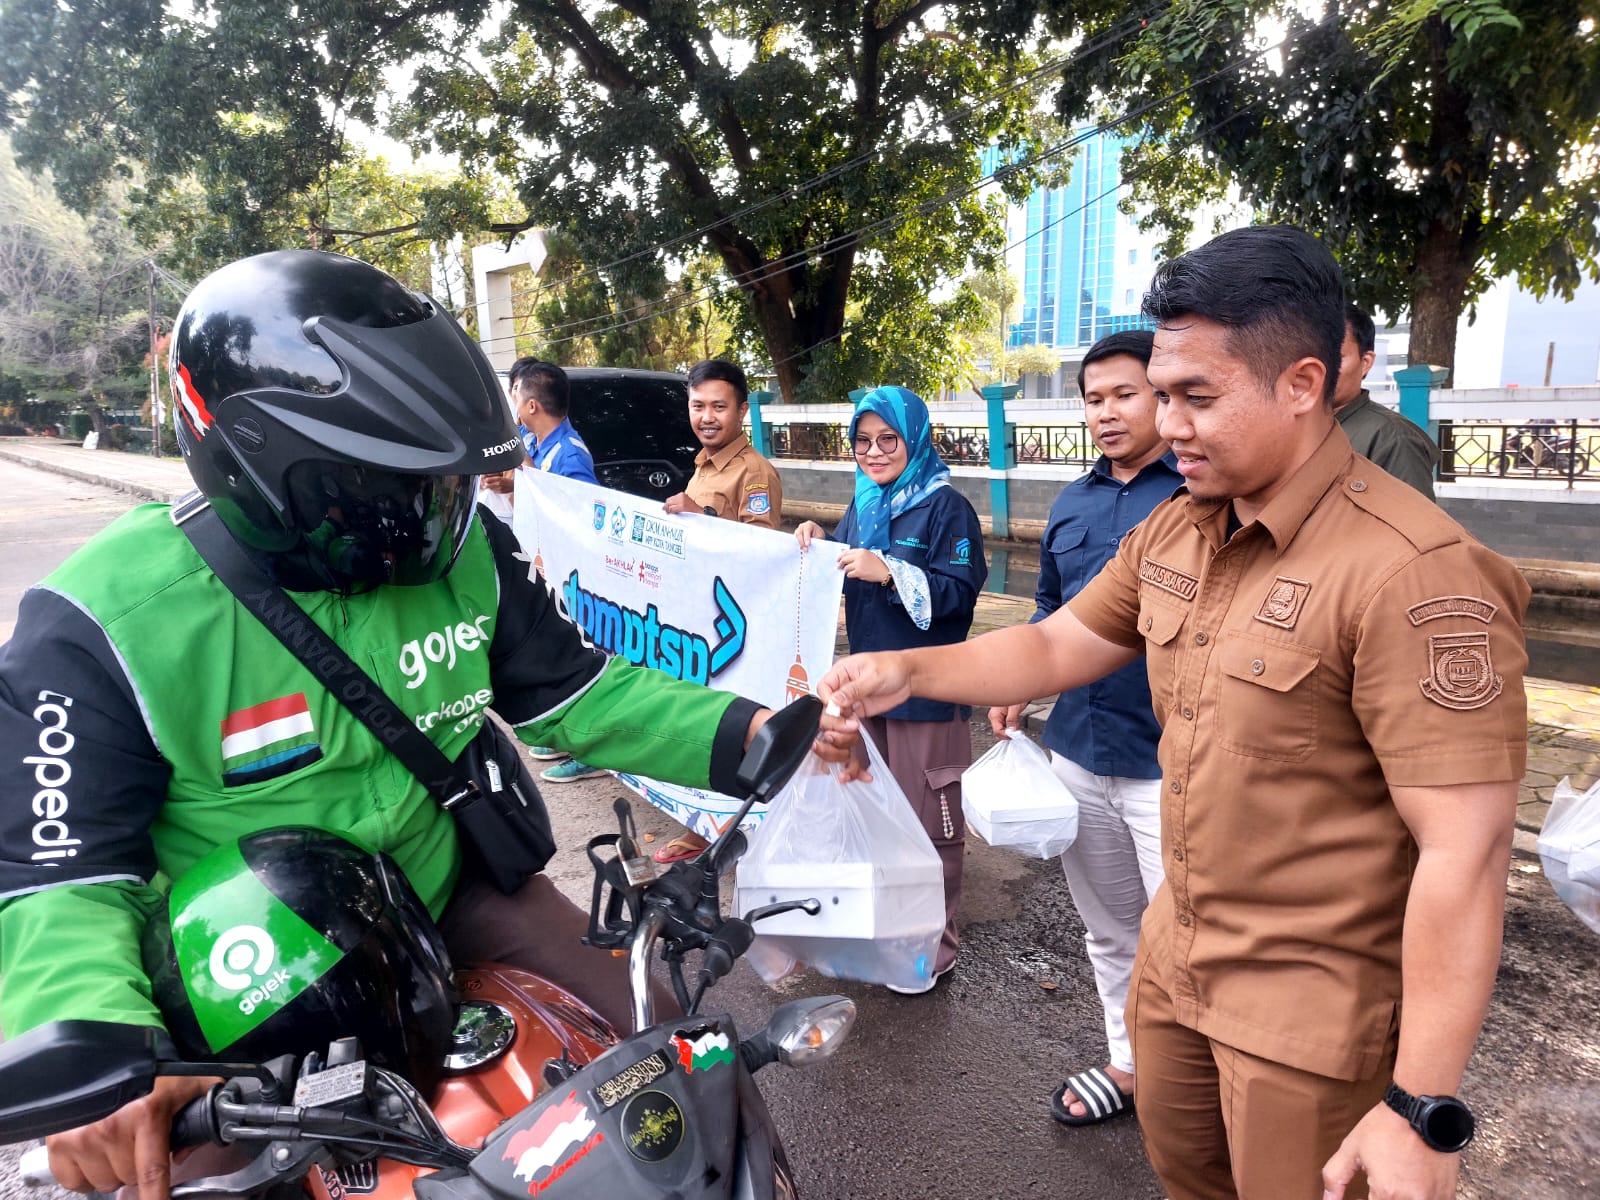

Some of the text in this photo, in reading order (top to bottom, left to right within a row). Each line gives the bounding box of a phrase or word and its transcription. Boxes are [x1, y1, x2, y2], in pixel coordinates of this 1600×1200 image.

[481, 436, 521, 457] HONDA
[1164, 570, 1196, 596] SAKTI
[246, 588, 409, 744] POLO DANNY
[238, 967, 292, 1016] gojek
[527, 1131, 605, 1199] Indonesia
